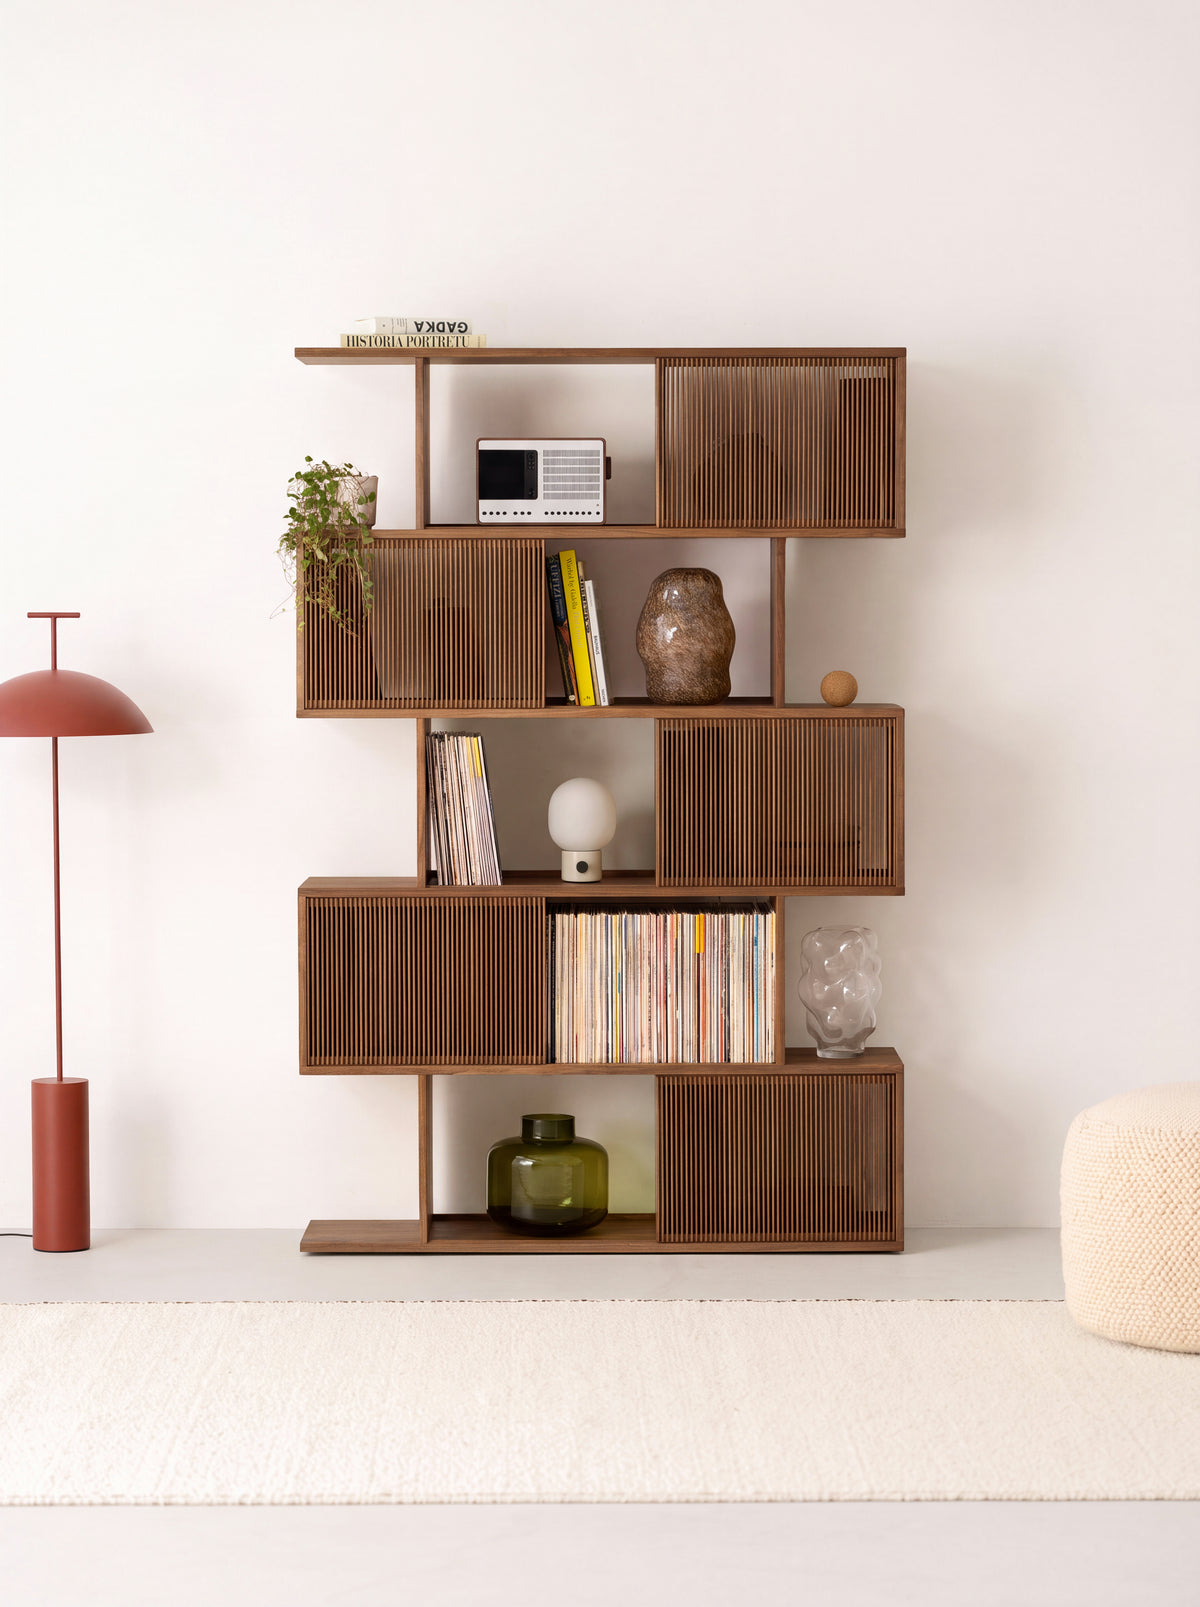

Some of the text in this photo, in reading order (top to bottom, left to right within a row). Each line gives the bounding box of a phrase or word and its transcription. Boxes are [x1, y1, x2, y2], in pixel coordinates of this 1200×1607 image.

[413, 320, 469, 334] GADKA
[346, 335, 403, 348] HISTORIA
[405, 335, 470, 348] PORTRETU
[566, 557, 575, 580] Warhol
[550, 564, 562, 598] UFFIZI
[593, 635, 601, 655] BAUHAUS
